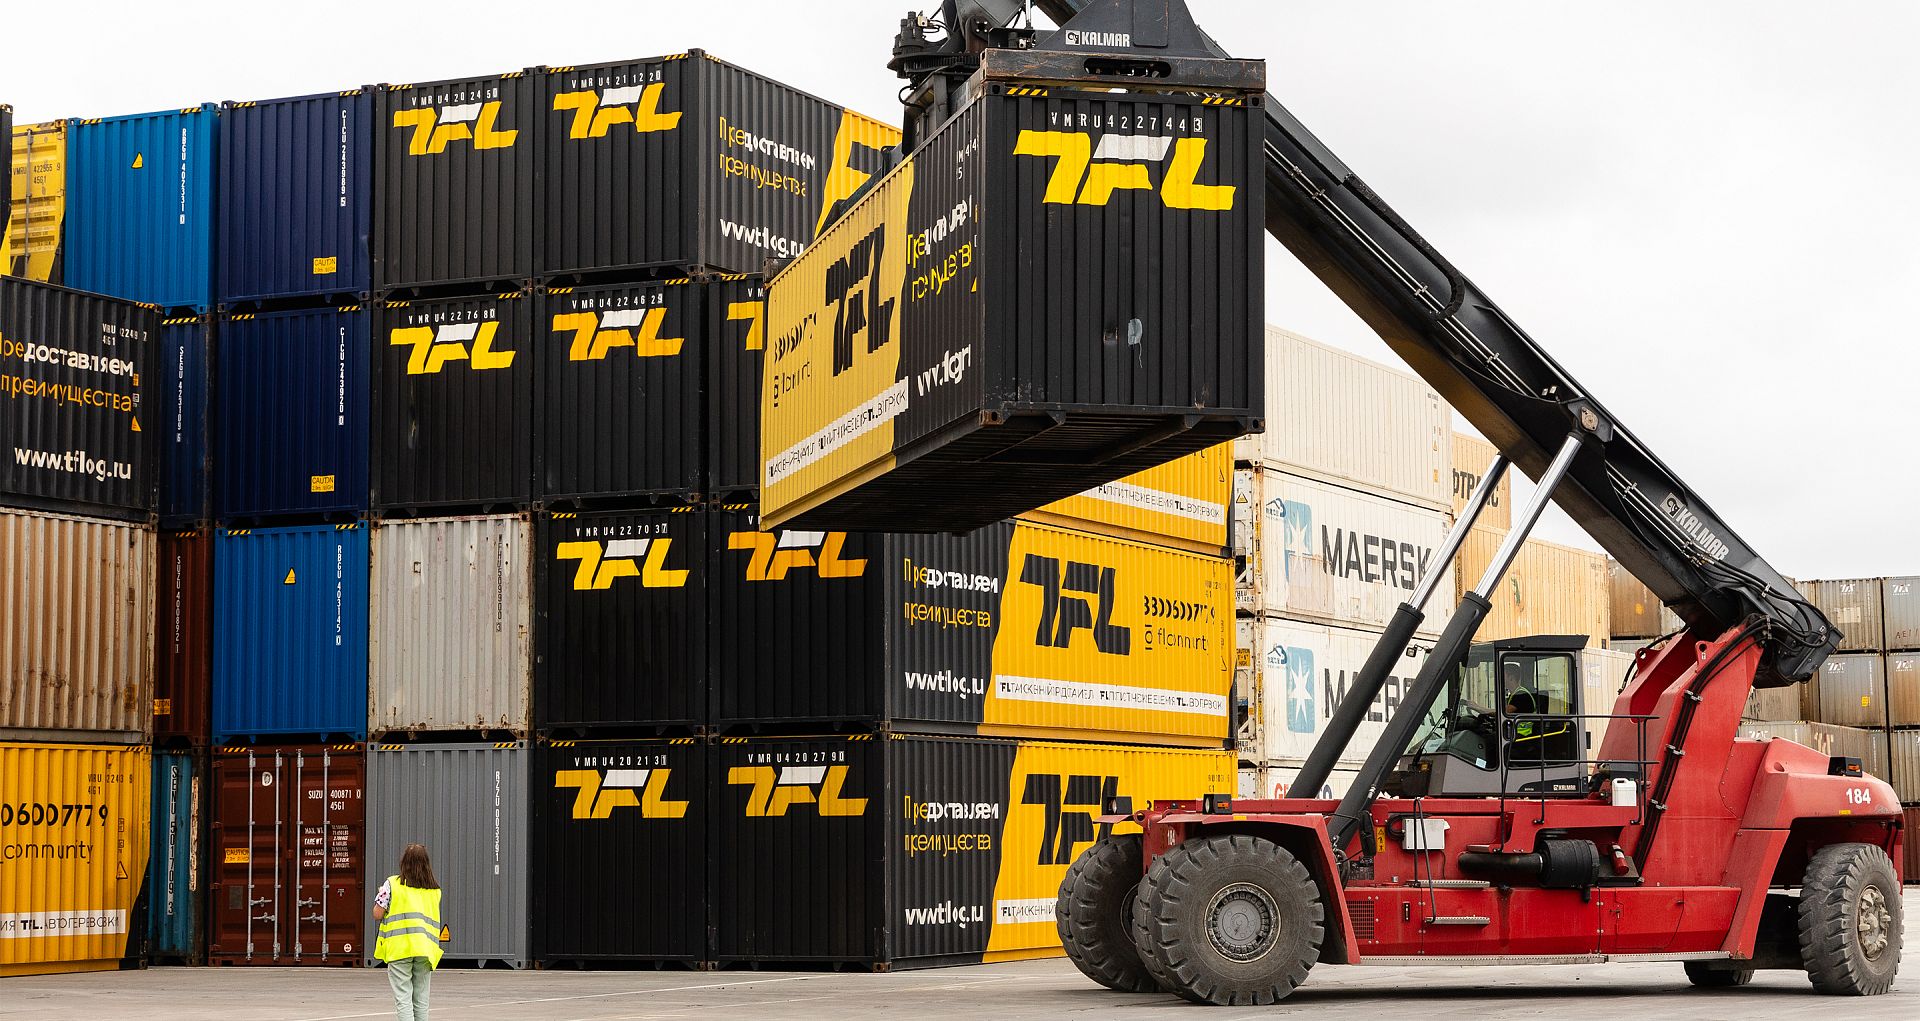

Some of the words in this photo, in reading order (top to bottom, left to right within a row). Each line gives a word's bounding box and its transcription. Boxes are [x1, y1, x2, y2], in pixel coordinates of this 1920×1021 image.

[1081, 32, 1130, 47] KALMAR
[394, 101, 518, 155] TFL
[553, 83, 682, 139] TFL
[1013, 130, 1236, 210] TFL
[340, 197, 346, 207] 5
[391, 321, 515, 374] TFL
[552, 308, 684, 361] TFL
[1, 374, 132, 412] преимущества
[338, 415, 344, 425] 0
[15, 447, 131, 481] www.tflog.ru
[728, 531, 868, 581] TFL
[1322, 524, 1431, 590] MAERSK
[1676, 508, 1729, 561] KALMAR
[557, 538, 689, 590] TFL
[904, 602, 991, 629] преимущесва
[1019, 553, 1131, 656] TFL
[336, 635, 342, 646] 0
[308, 790, 324, 799] SUZU
[330, 789, 352, 799] 400871
[356, 789, 361, 799] 0
[330, 801, 345, 811] 45G1
[555, 769, 688, 819] TFL
[728, 766, 868, 816] TFL
[1846, 788, 1871, 805] 184
[905, 834, 991, 857] преимущесва
